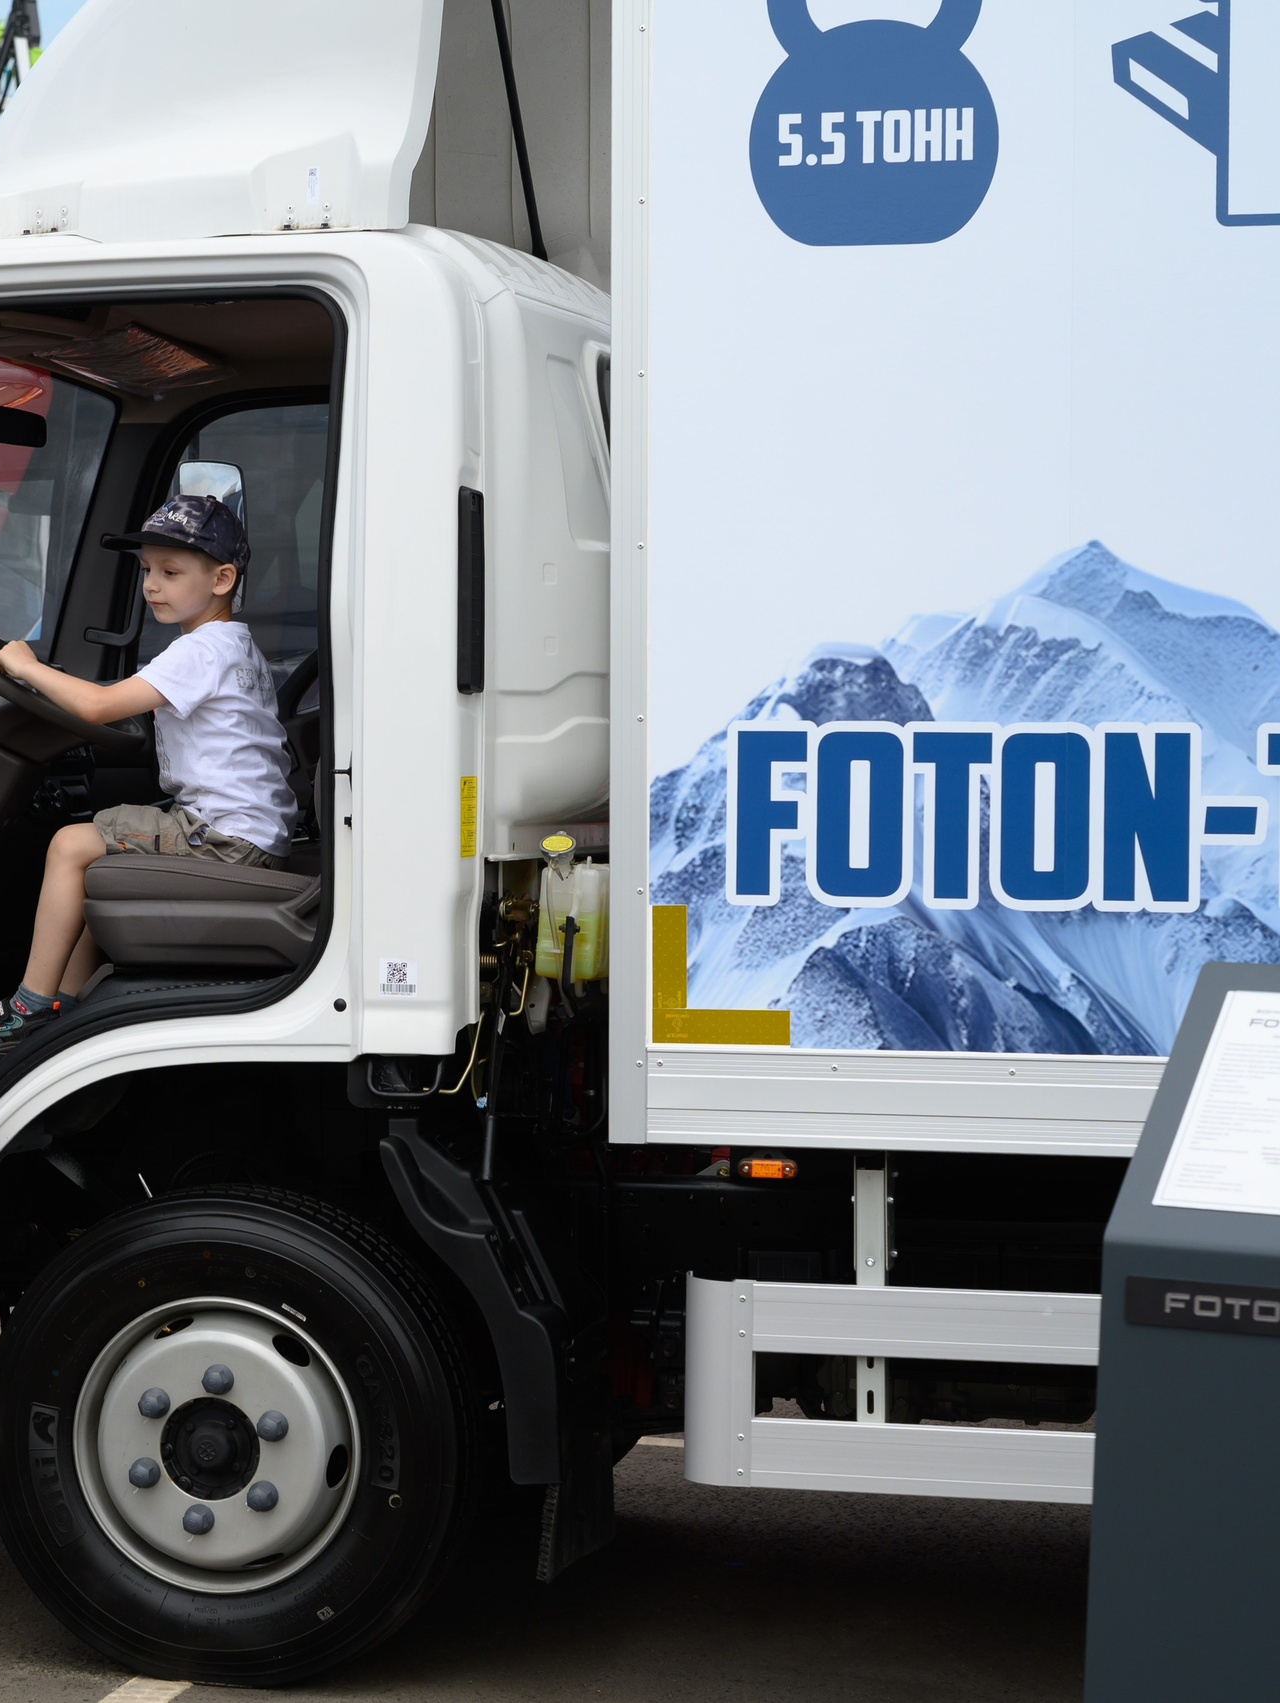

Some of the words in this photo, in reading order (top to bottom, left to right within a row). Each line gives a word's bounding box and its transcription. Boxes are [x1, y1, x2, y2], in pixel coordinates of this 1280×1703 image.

[778, 111, 846, 166] 5.5
[856, 107, 974, 164] ТОНН
[734, 728, 1280, 905] FOTON-
[34, 1456, 71, 1534] Giti
